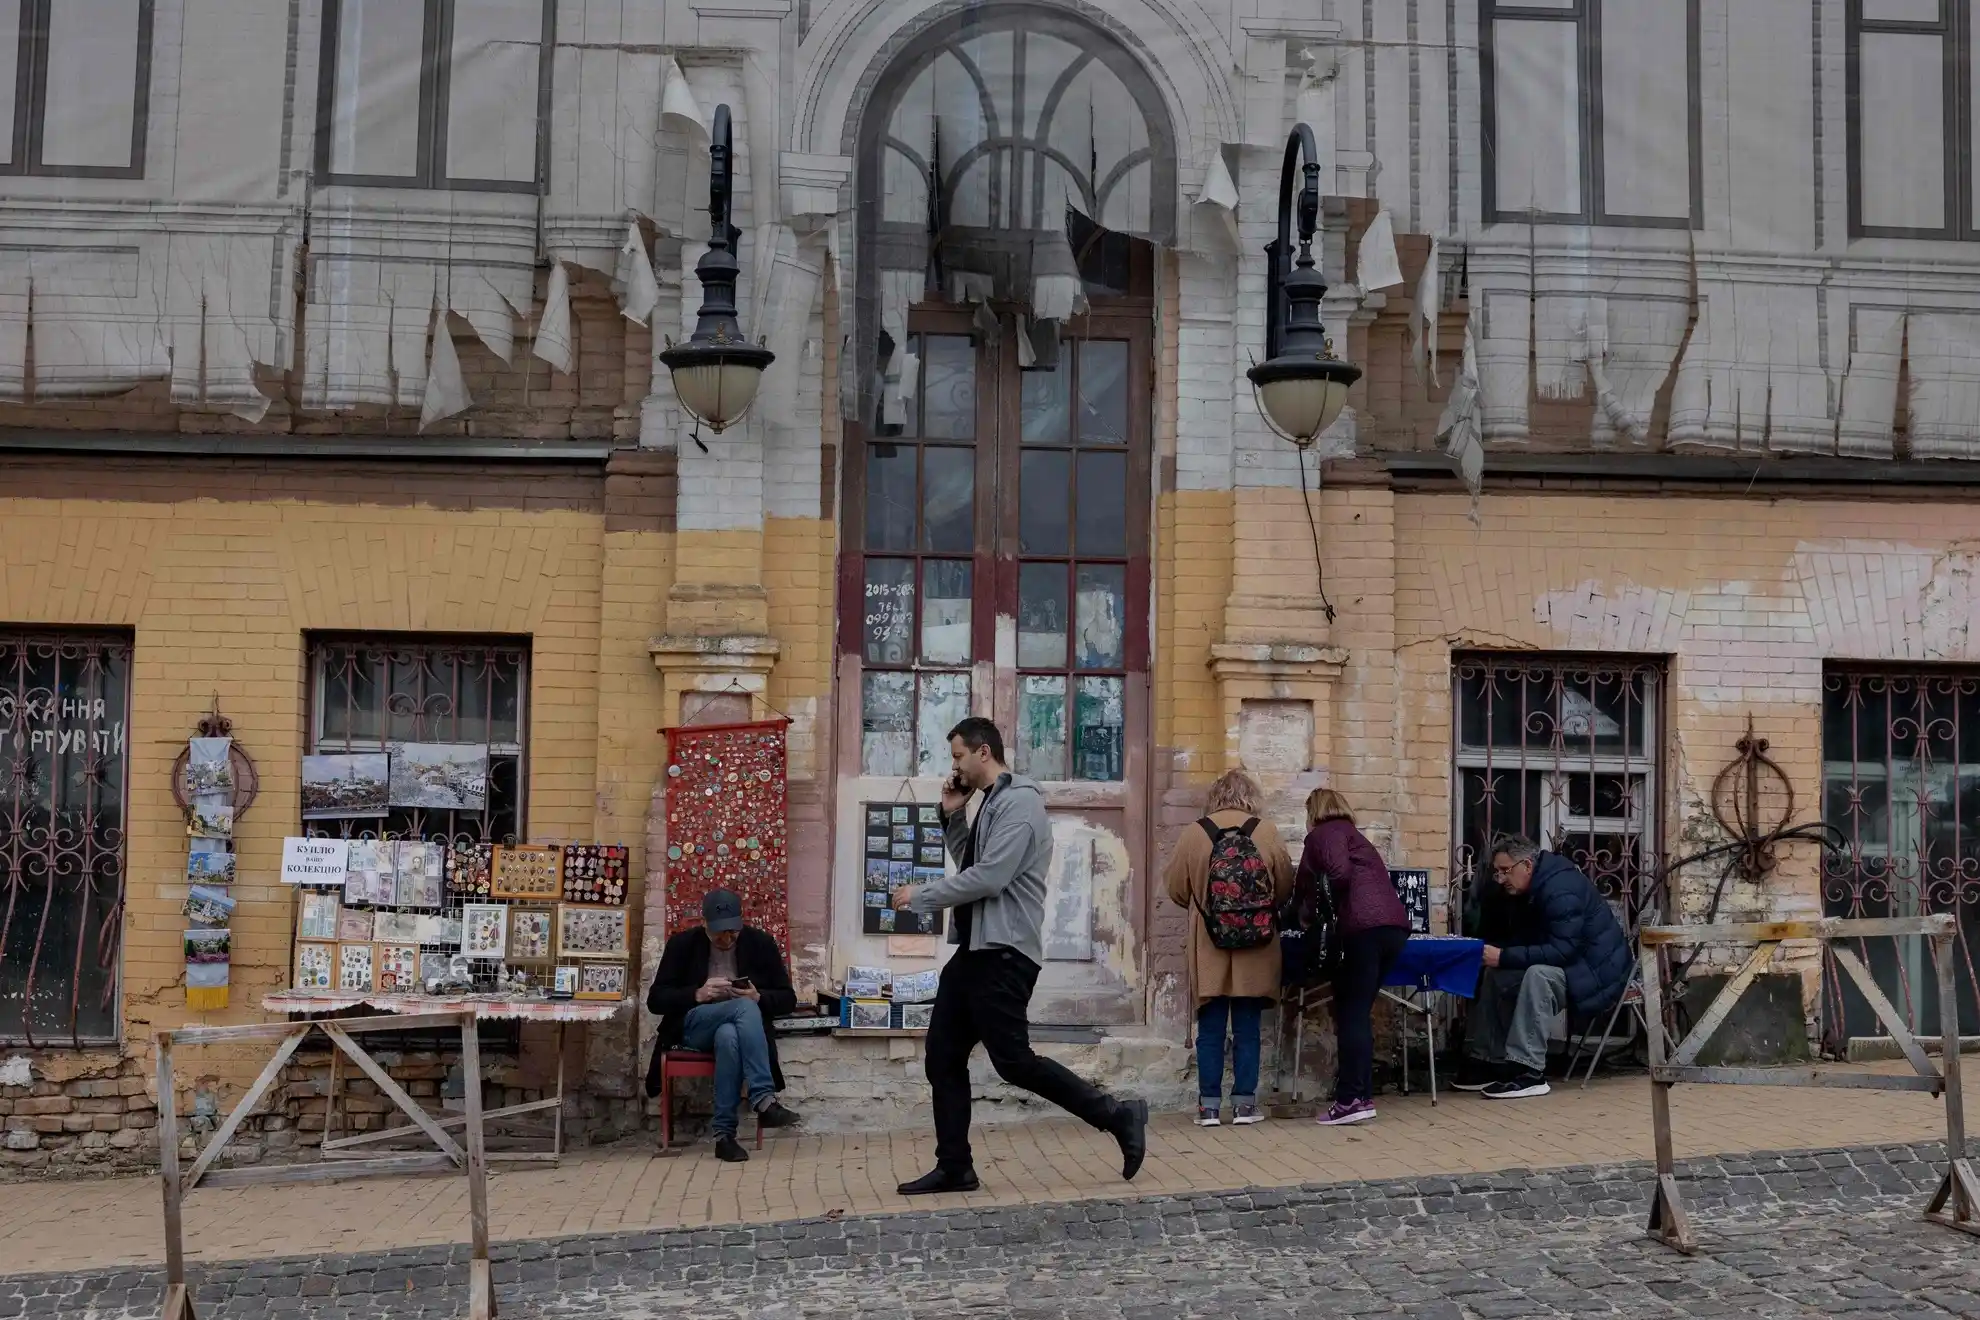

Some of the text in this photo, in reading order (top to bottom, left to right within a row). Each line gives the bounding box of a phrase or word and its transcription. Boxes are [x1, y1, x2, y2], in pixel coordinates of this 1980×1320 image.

[866, 612, 889, 625] 099
[296, 845, 335, 855] КУПЛЮ
[287, 864, 342, 875] КОЛЕКЦІЮ
